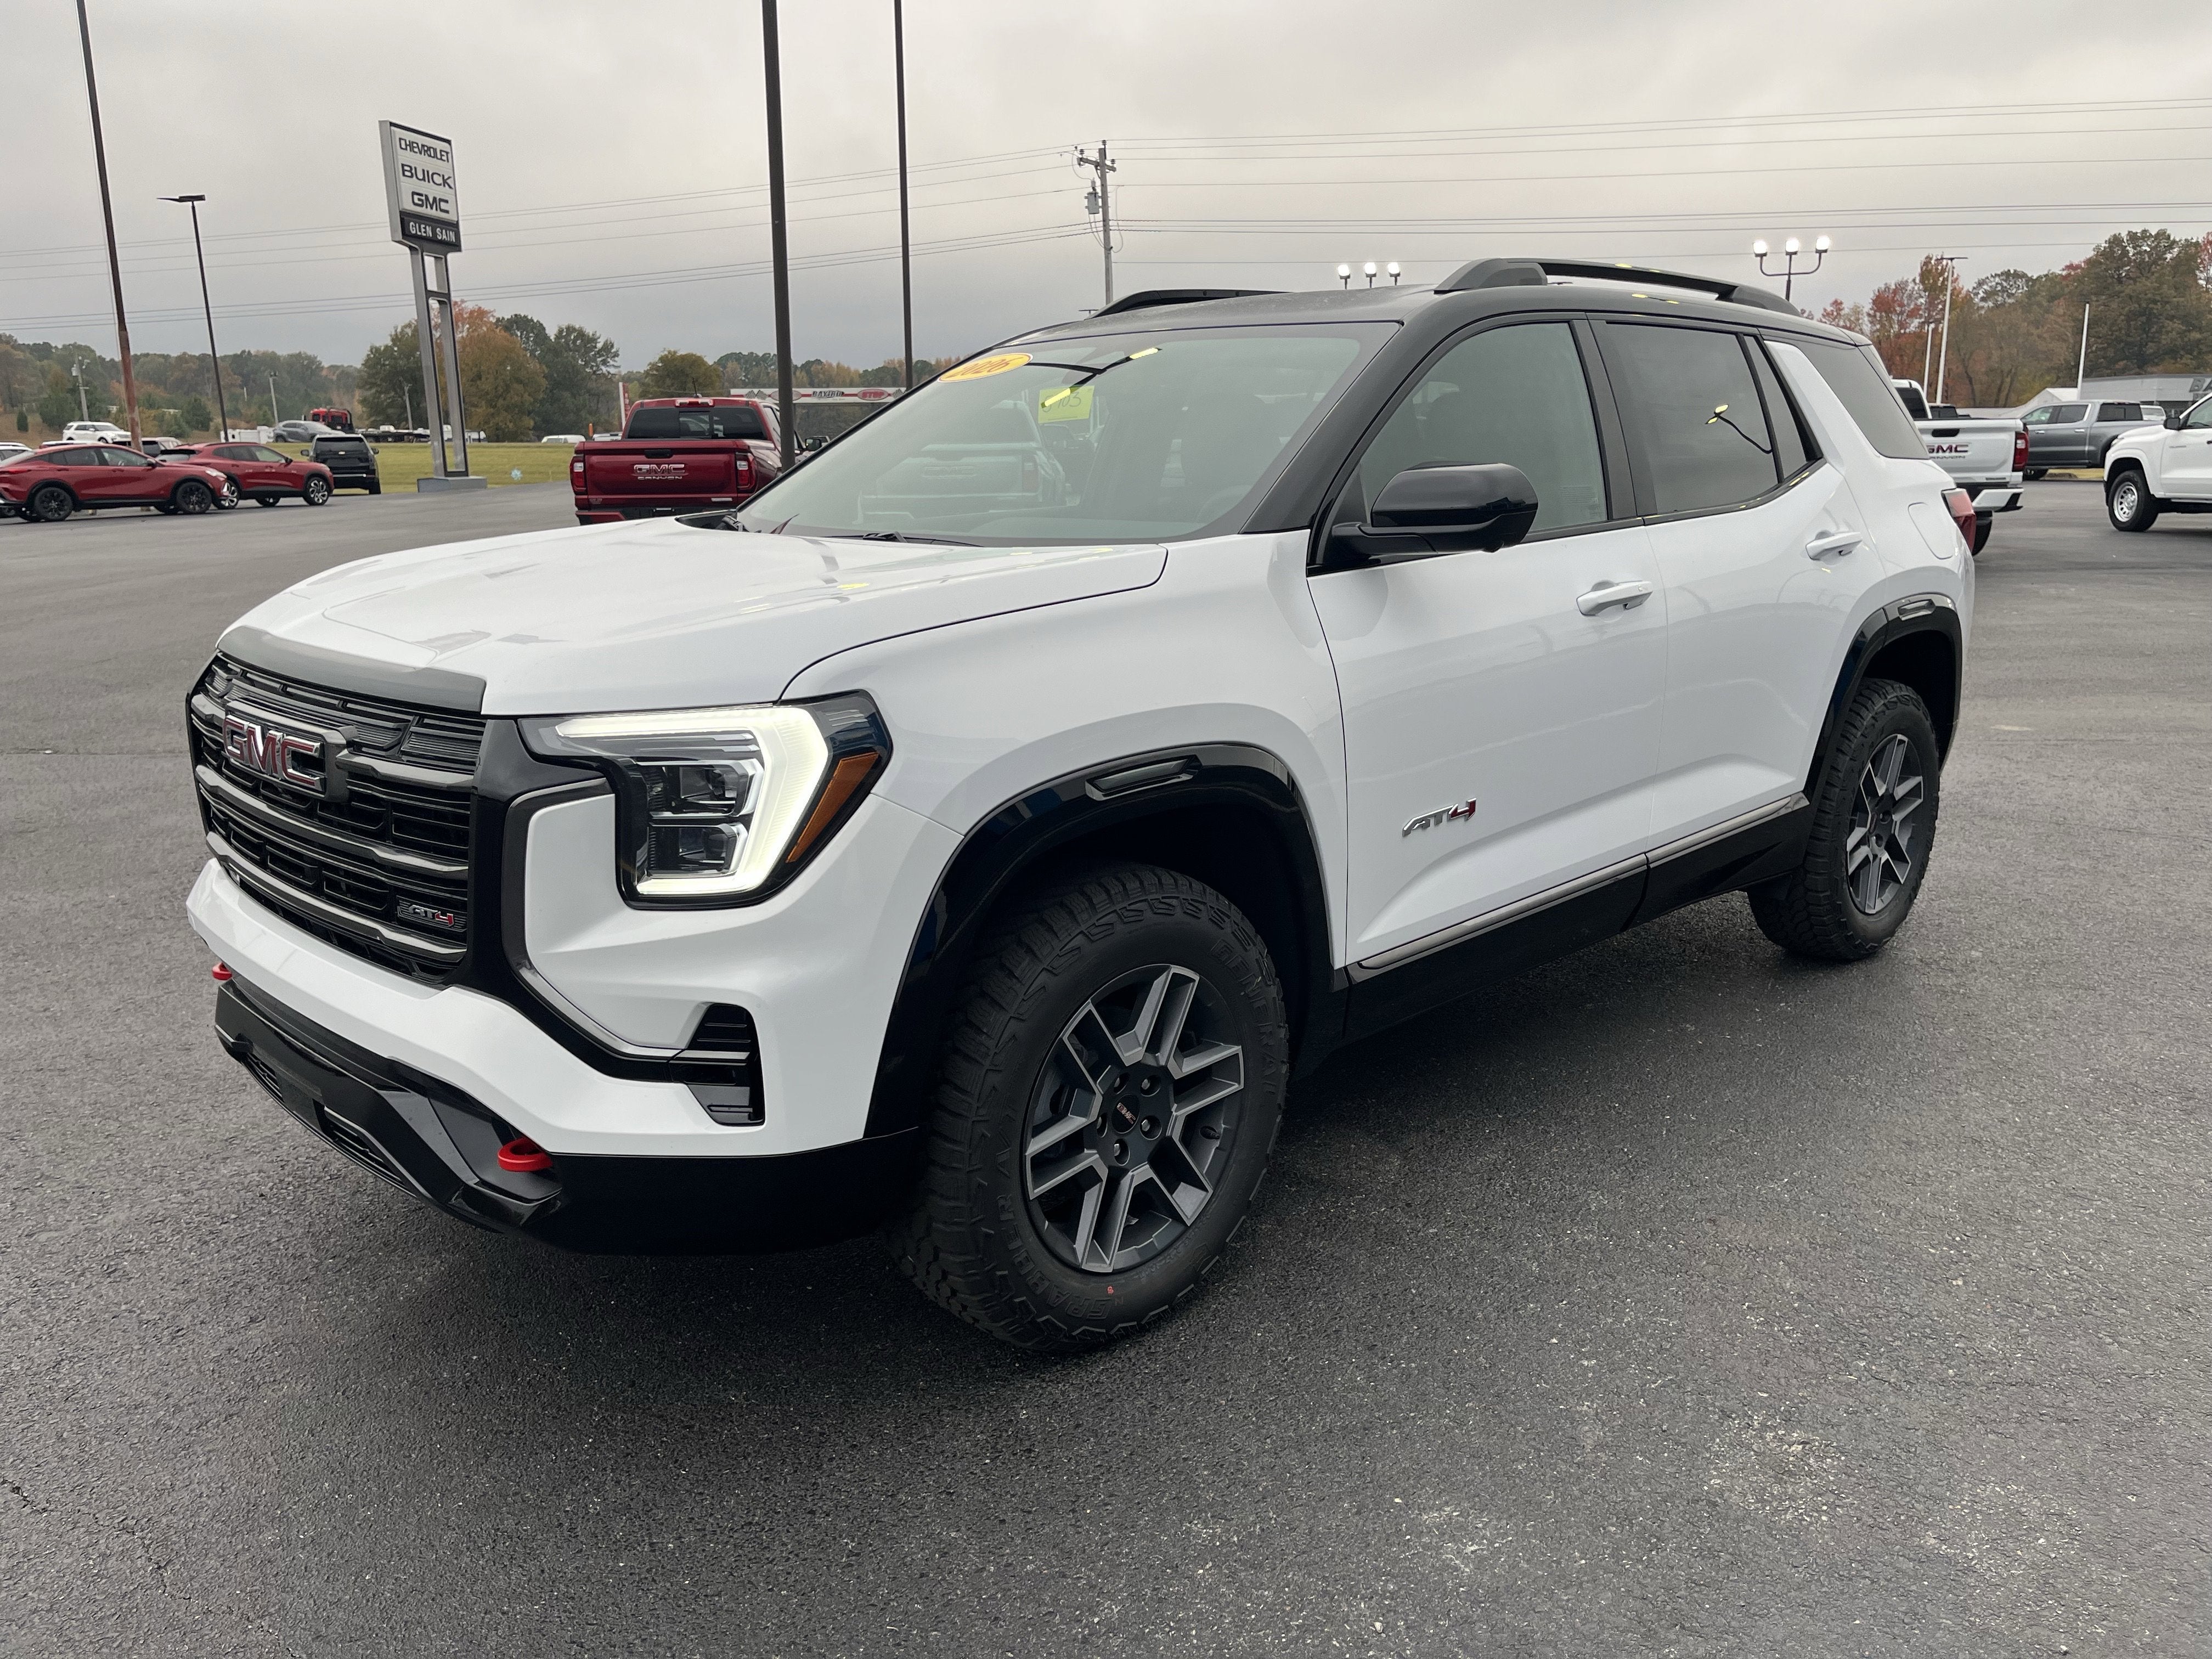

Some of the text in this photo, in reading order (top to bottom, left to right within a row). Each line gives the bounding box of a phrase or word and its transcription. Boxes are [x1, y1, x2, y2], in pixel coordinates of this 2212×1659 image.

[399, 137, 450, 163] CHEVROLET
[401, 163, 453, 189] BUICK
[411, 191, 449, 215] GMC
[409, 222, 456, 242] GLEN SAIN
[944, 357, 1024, 379] 2026
[634, 464, 685, 473] GMC
[222, 714, 326, 792] GMC
[1402, 798, 1477, 838] AT4
[408, 904, 454, 927] AT4
[1117, 1102, 1136, 1125] GMC
[996, 1194, 1114, 1321] GRABBER
